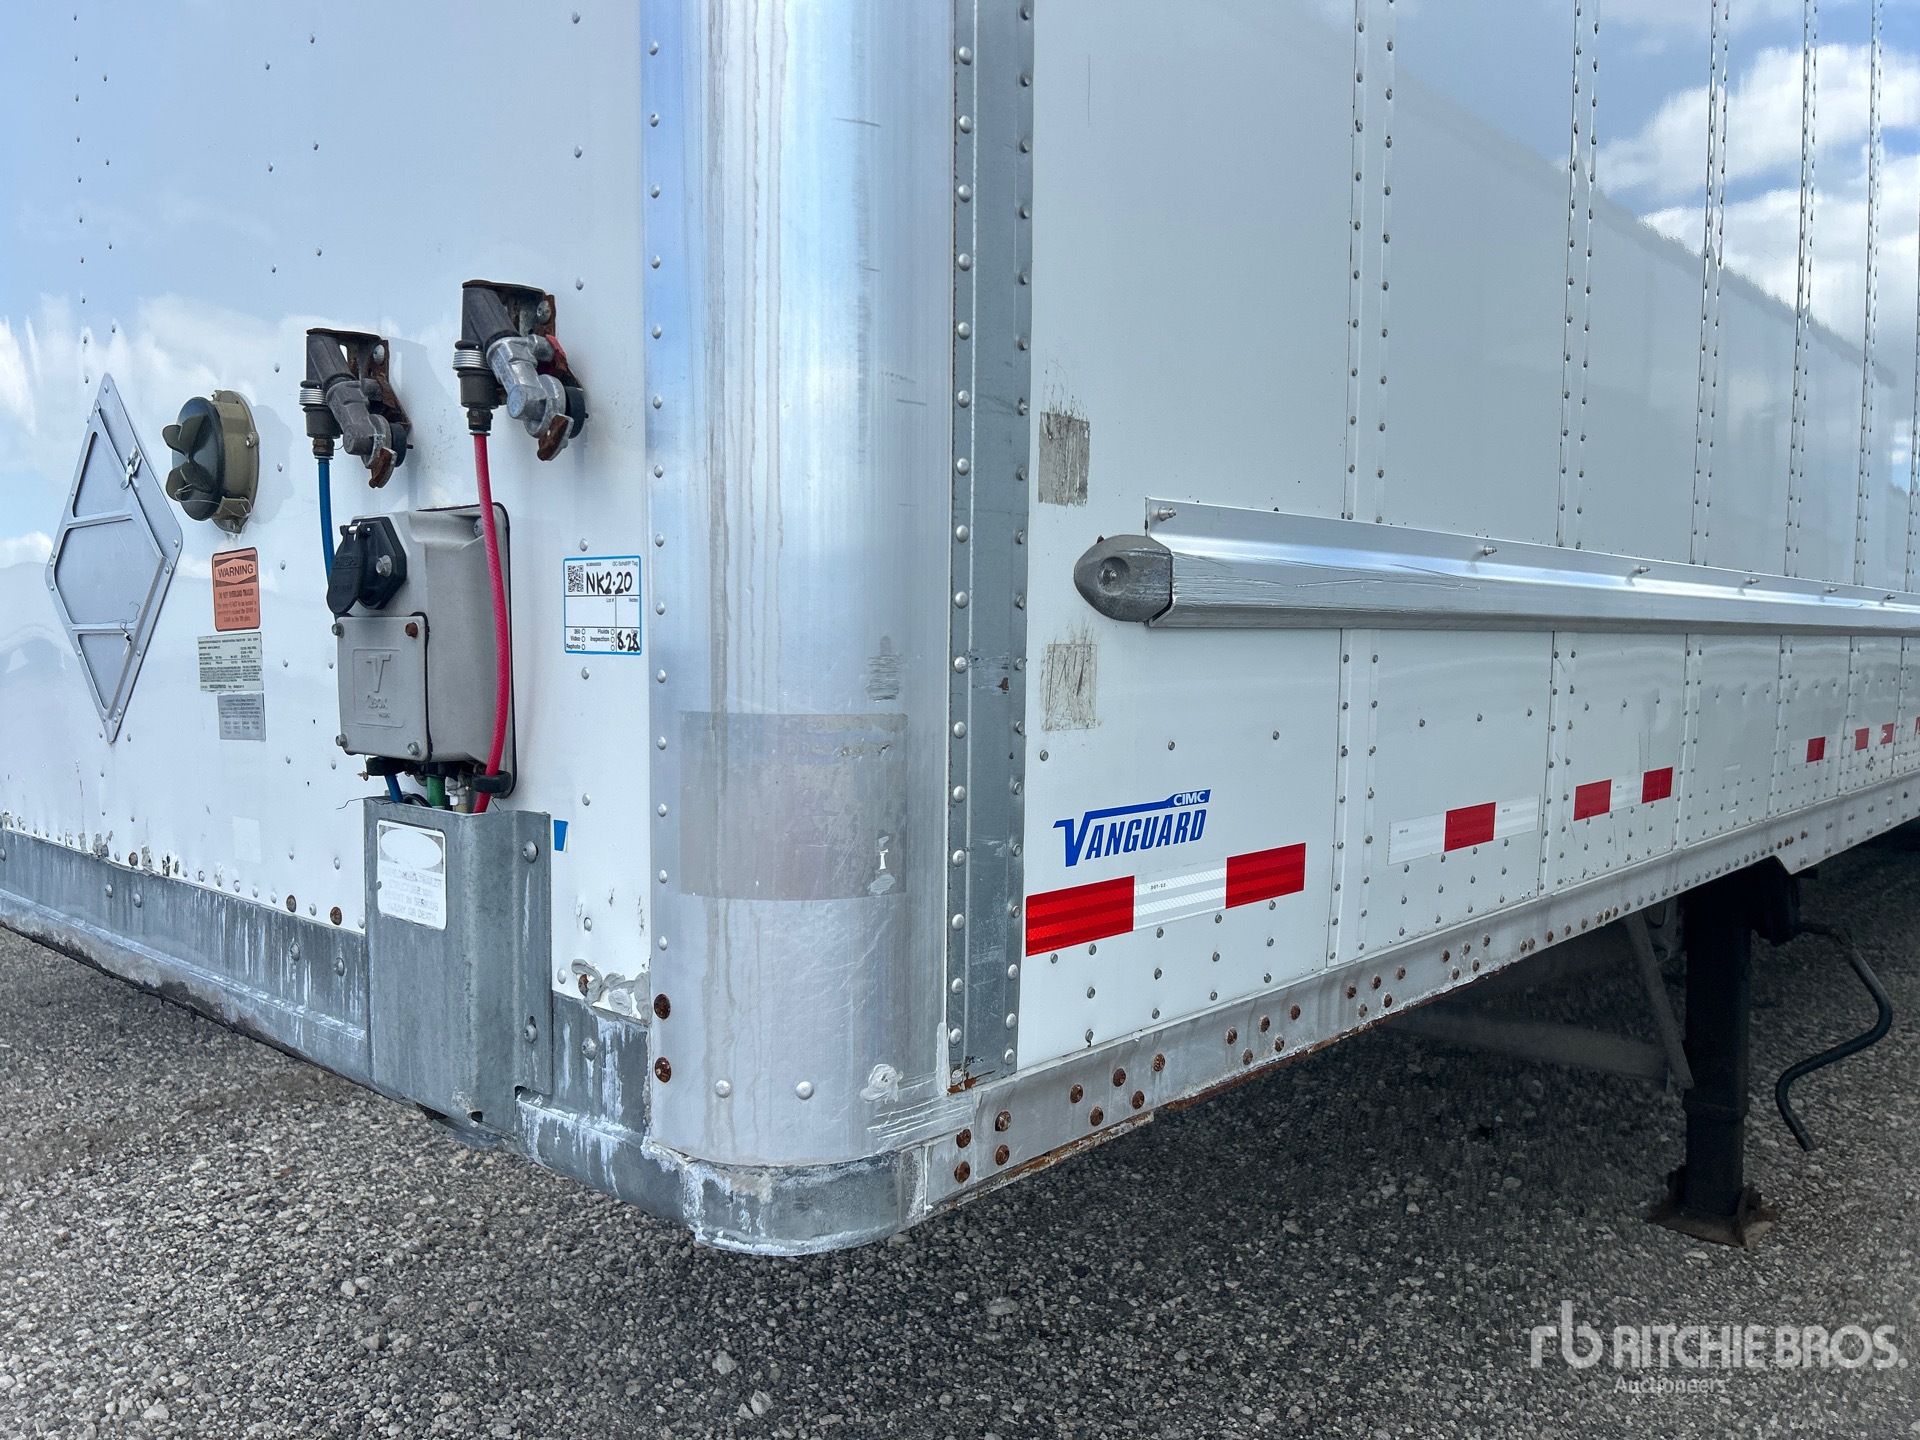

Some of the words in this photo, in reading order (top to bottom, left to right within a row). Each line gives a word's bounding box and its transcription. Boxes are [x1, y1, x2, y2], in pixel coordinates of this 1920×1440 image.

[218, 563, 254, 578] WARNING
[1173, 790, 1206, 807] CIMC
[1053, 809, 1208, 868] VANGUARD
